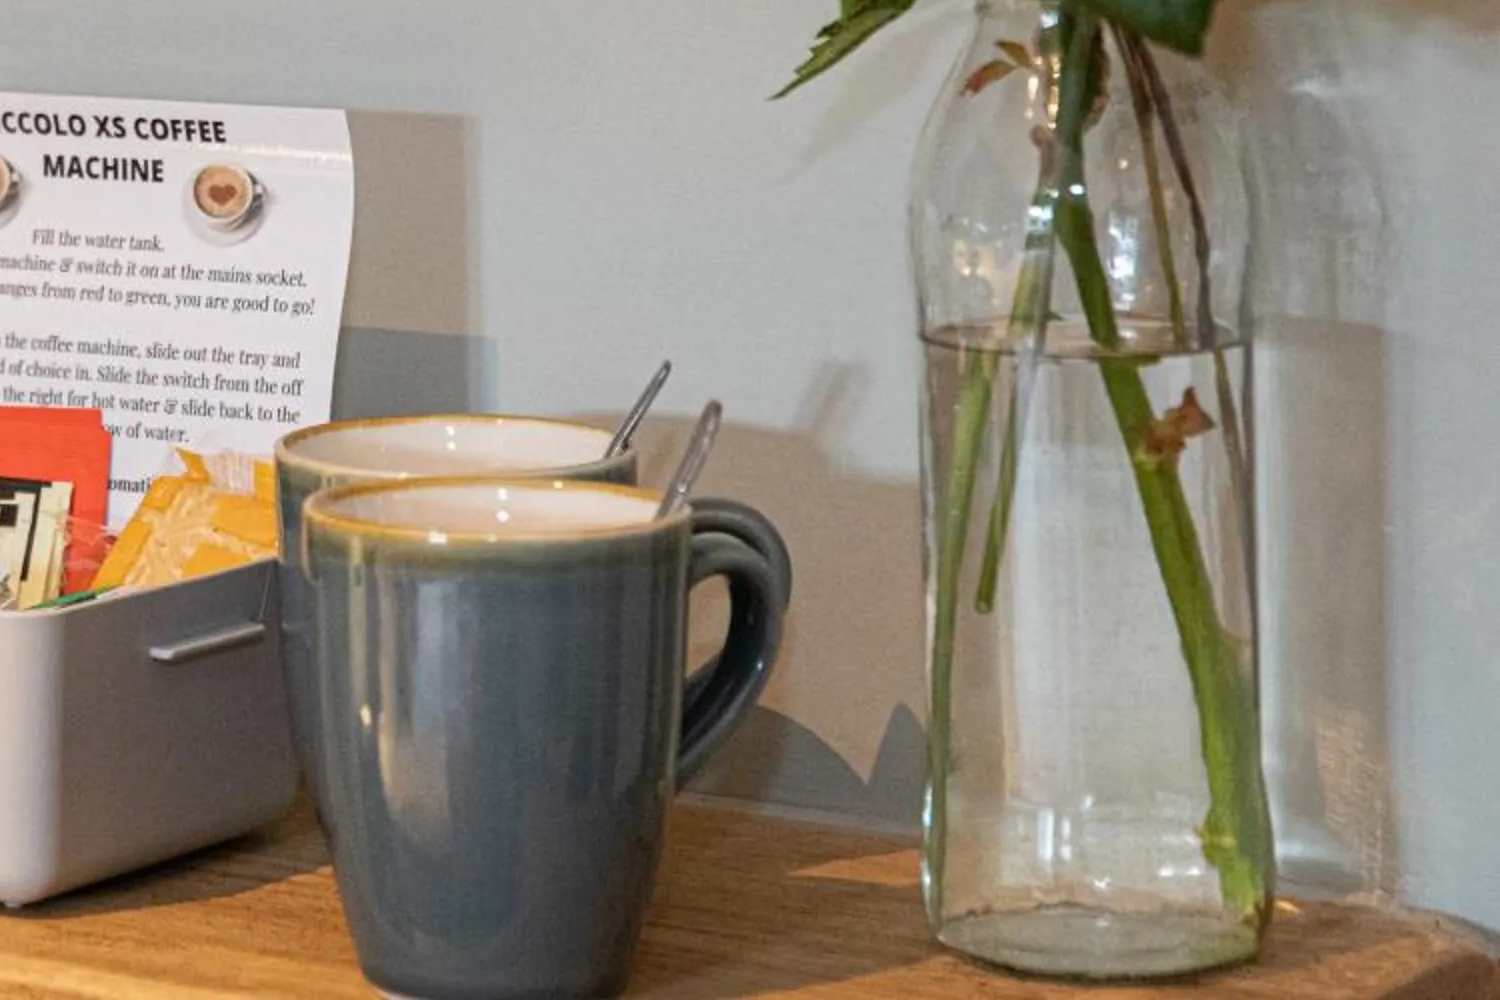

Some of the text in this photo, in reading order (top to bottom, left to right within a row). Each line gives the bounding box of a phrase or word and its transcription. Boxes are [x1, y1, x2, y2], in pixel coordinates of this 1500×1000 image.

[93, 115, 126, 139] XS
[134, 118, 226, 143] COFFEE
[43, 154, 164, 182] MACHINE
[32, 229, 165, 251] Fill the water tank.
[59, 257, 73, 273] &
[76, 257, 121, 276] switch
[125, 260, 136, 277] it
[139, 265, 158, 278] on
[162, 265, 176, 279] at
[181, 263, 204, 281] the
[208, 267, 252, 284] mains
[255, 268, 307, 288] socket.
[41, 281, 76, 299] from
[79, 284, 104, 300] red
[108, 287, 123, 301] to
[126, 290, 171, 306] green,
[174, 294, 201, 310] you
[204, 296, 228, 309] are
[232, 295, 268, 313] good
[273, 298, 288, 312] to
[292, 298, 315, 316] go!
[5, 331, 27, 349] the
[31, 335, 73, 352] coffee
[77, 339, 141, 358] machine,
[146, 342, 181, 361] slide
[183, 346, 208, 362] out
[212, 347, 235, 365] the
[239, 349, 267, 369] tray
[272, 351, 300, 369] and
[8, 359, 23, 375] of
[26, 361, 71, 379] choice
[75, 364, 93, 381] in.
[97, 365, 132, 383] Slide
[136, 367, 158, 385] the
[162, 370, 209, 389] switch
[214, 374, 249, 392] from
[253, 376, 278, 395] the
[281, 378, 304, 397] off
[3, 384, 25, 402] the
[29, 388, 63, 408] right
[67, 389, 89, 406] for
[92, 391, 115, 410] hot
[119, 396, 160, 413] water
[163, 399, 178, 414] &
[181, 399, 215, 418] slide
[220, 402, 253, 420] back
[257, 406, 273, 421] to
[277, 405, 300, 424] the
[126, 421, 143, 438] of
[144, 425, 190, 443] water.
